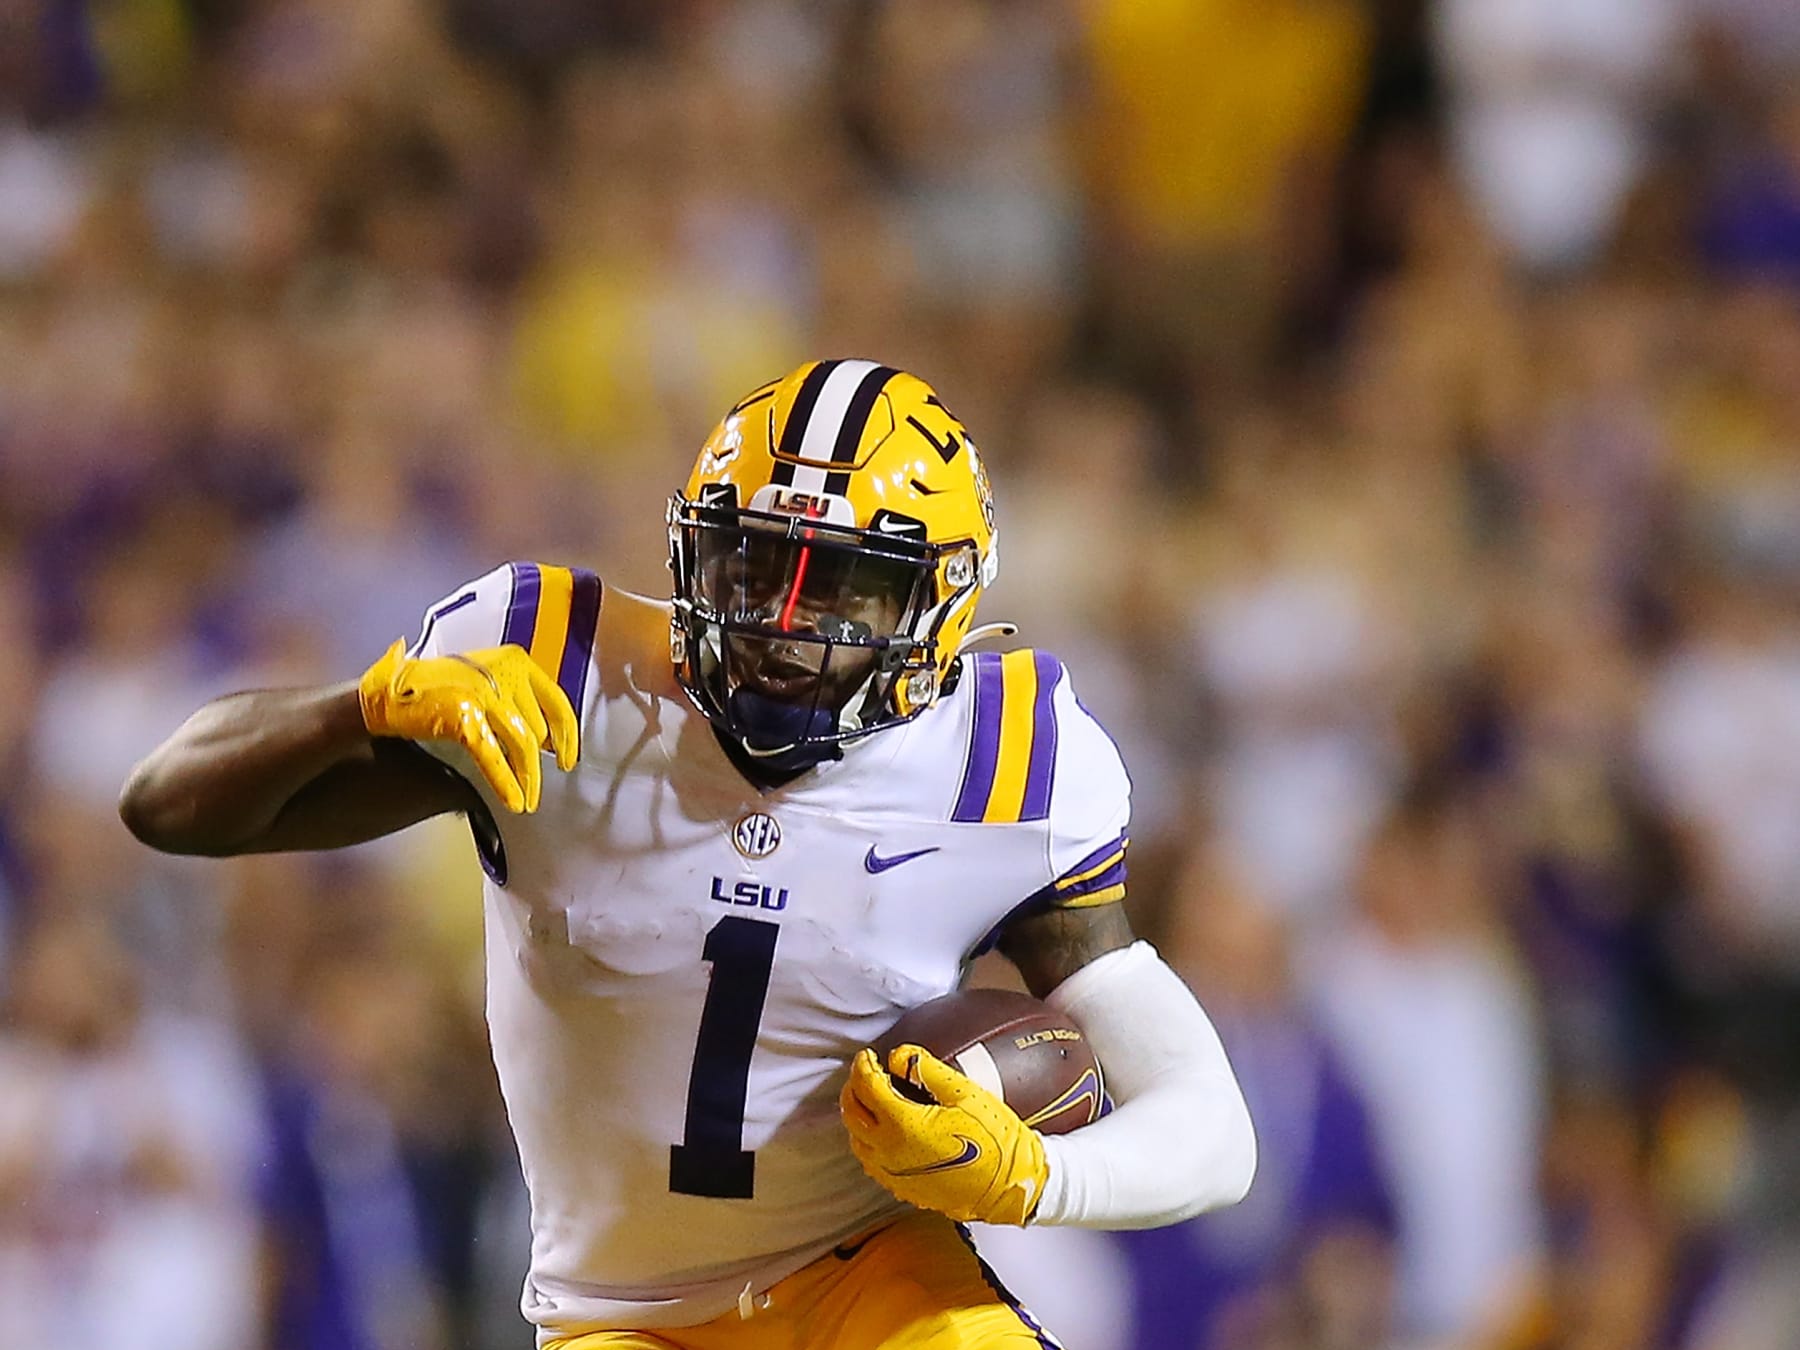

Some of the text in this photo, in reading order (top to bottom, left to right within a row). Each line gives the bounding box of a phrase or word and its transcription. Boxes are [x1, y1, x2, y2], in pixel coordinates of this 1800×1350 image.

[770, 489, 831, 518] LSU
[738, 814, 780, 856] SEC
[711, 876, 788, 911] LSU
[669, 914, 780, 1199] 1
